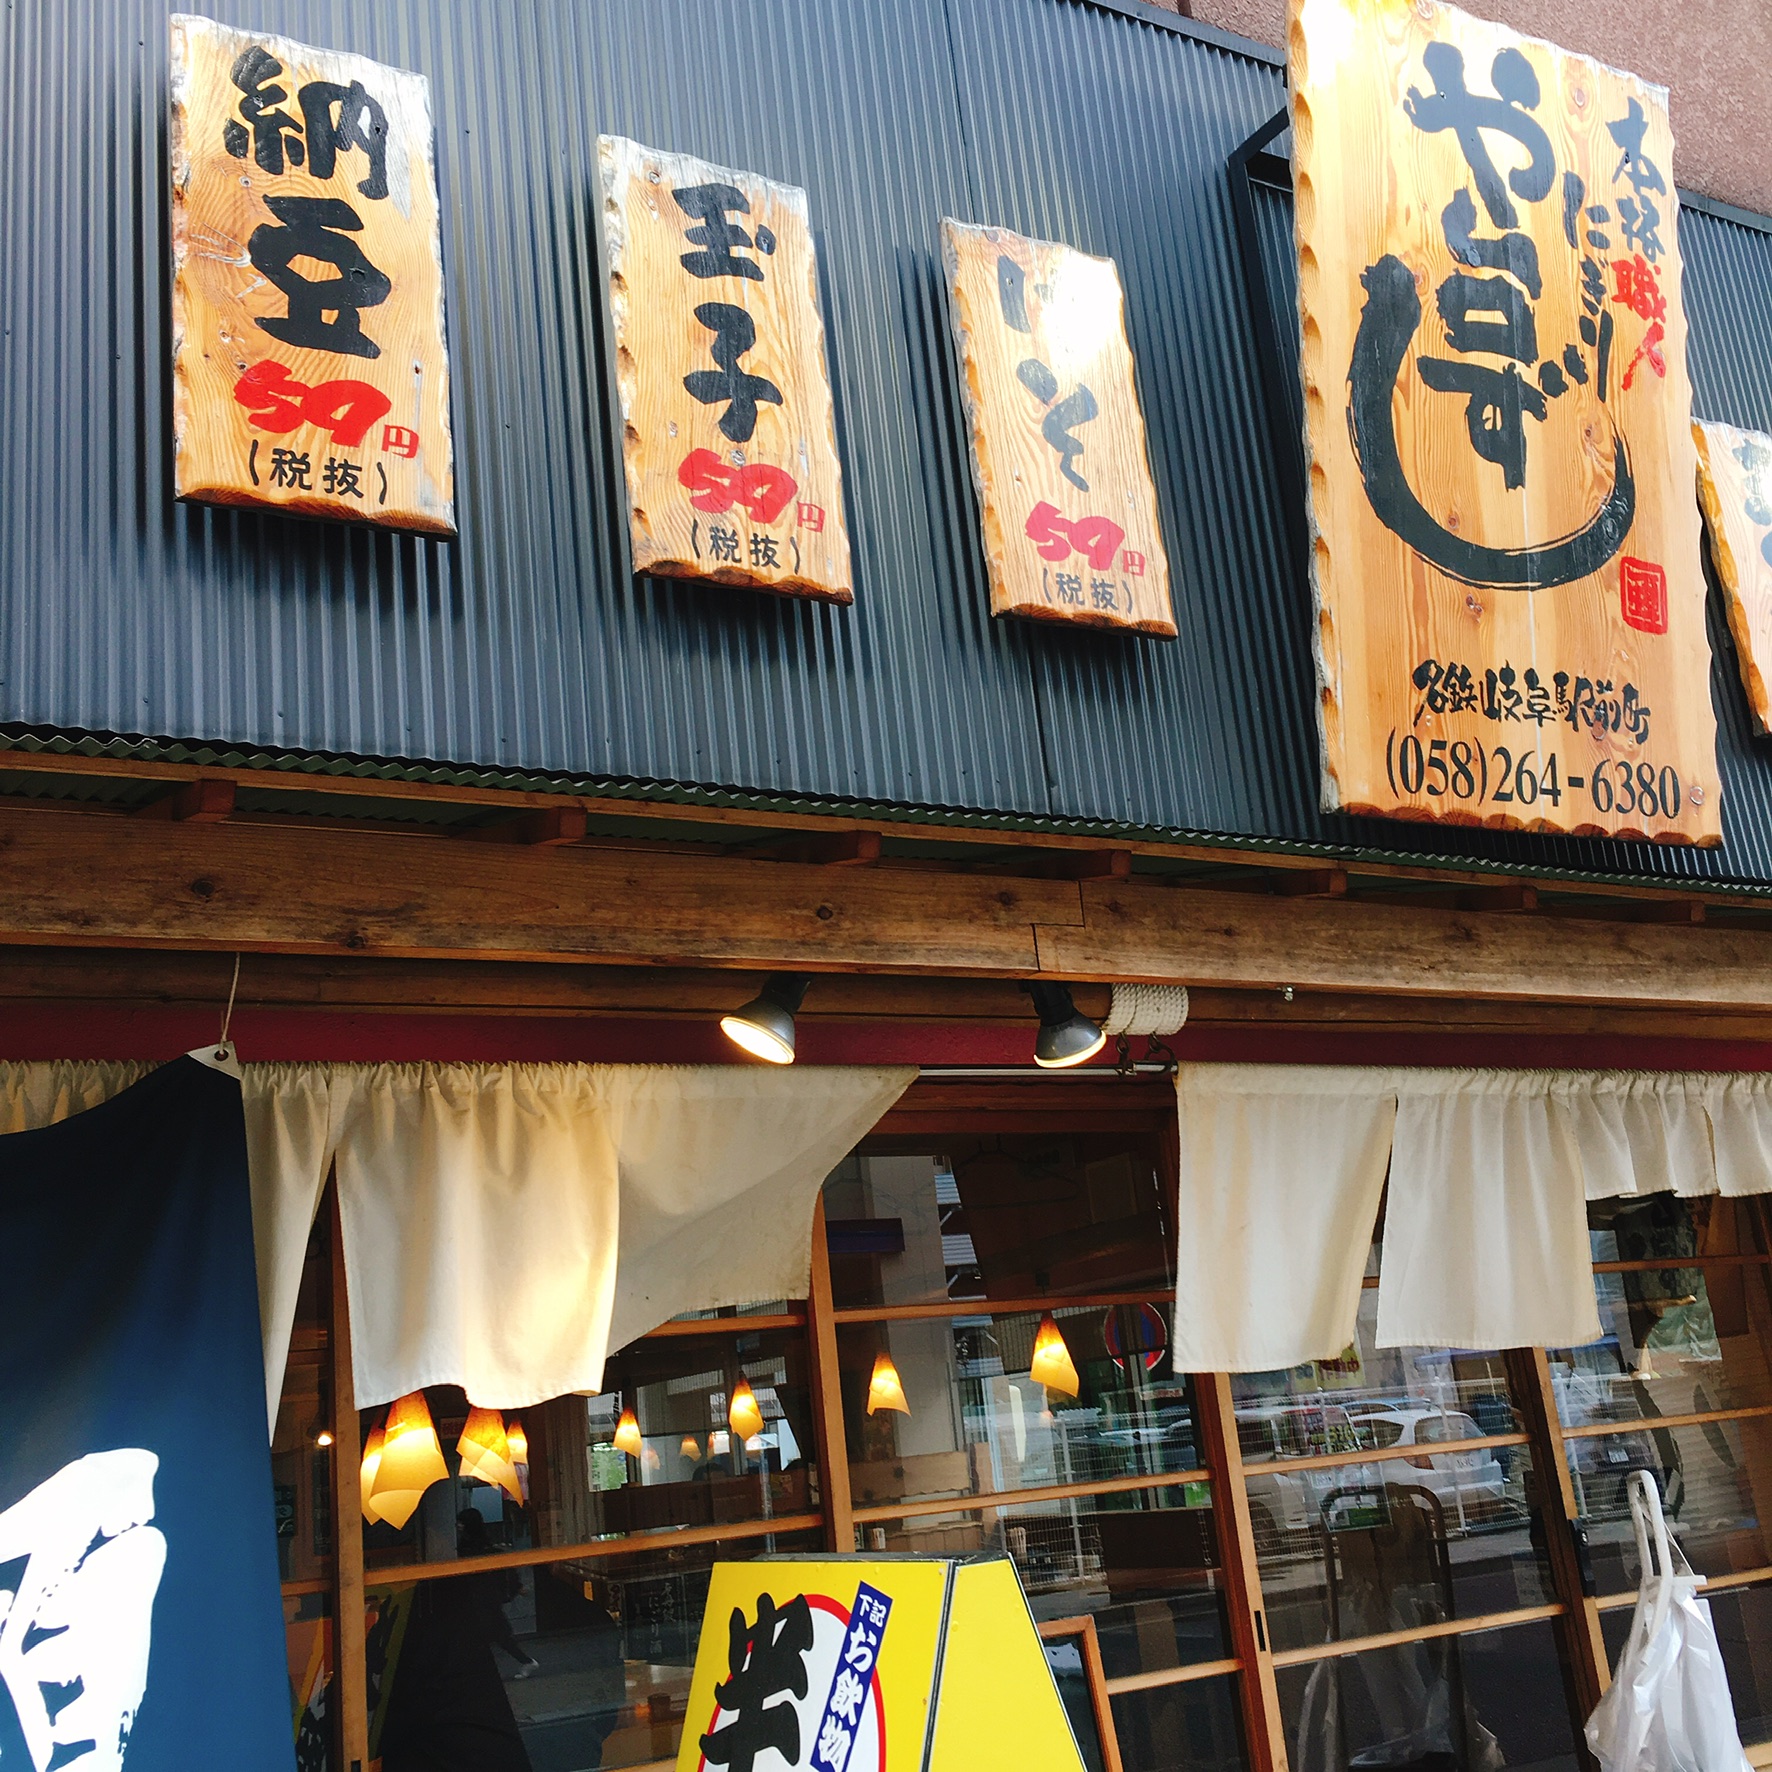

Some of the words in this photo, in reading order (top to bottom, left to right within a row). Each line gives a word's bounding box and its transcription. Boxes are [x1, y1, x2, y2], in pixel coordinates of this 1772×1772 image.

[223, 45, 392, 359] 納豆
[1605, 96, 1667, 391] 本格職人
[672, 182, 783, 443] 玉子
[1563, 169, 1614, 404] にぎり
[233, 359, 420, 460] 50円
[248, 440, 389, 505] (税抜)
[677, 447, 826, 534] 50円
[690, 519, 801, 574] (税抜)
[1024, 500, 1147, 576] 50円
[1042, 568, 1134, 612] (税抜)
[1386, 726, 1681, 820] (058)264-6380
